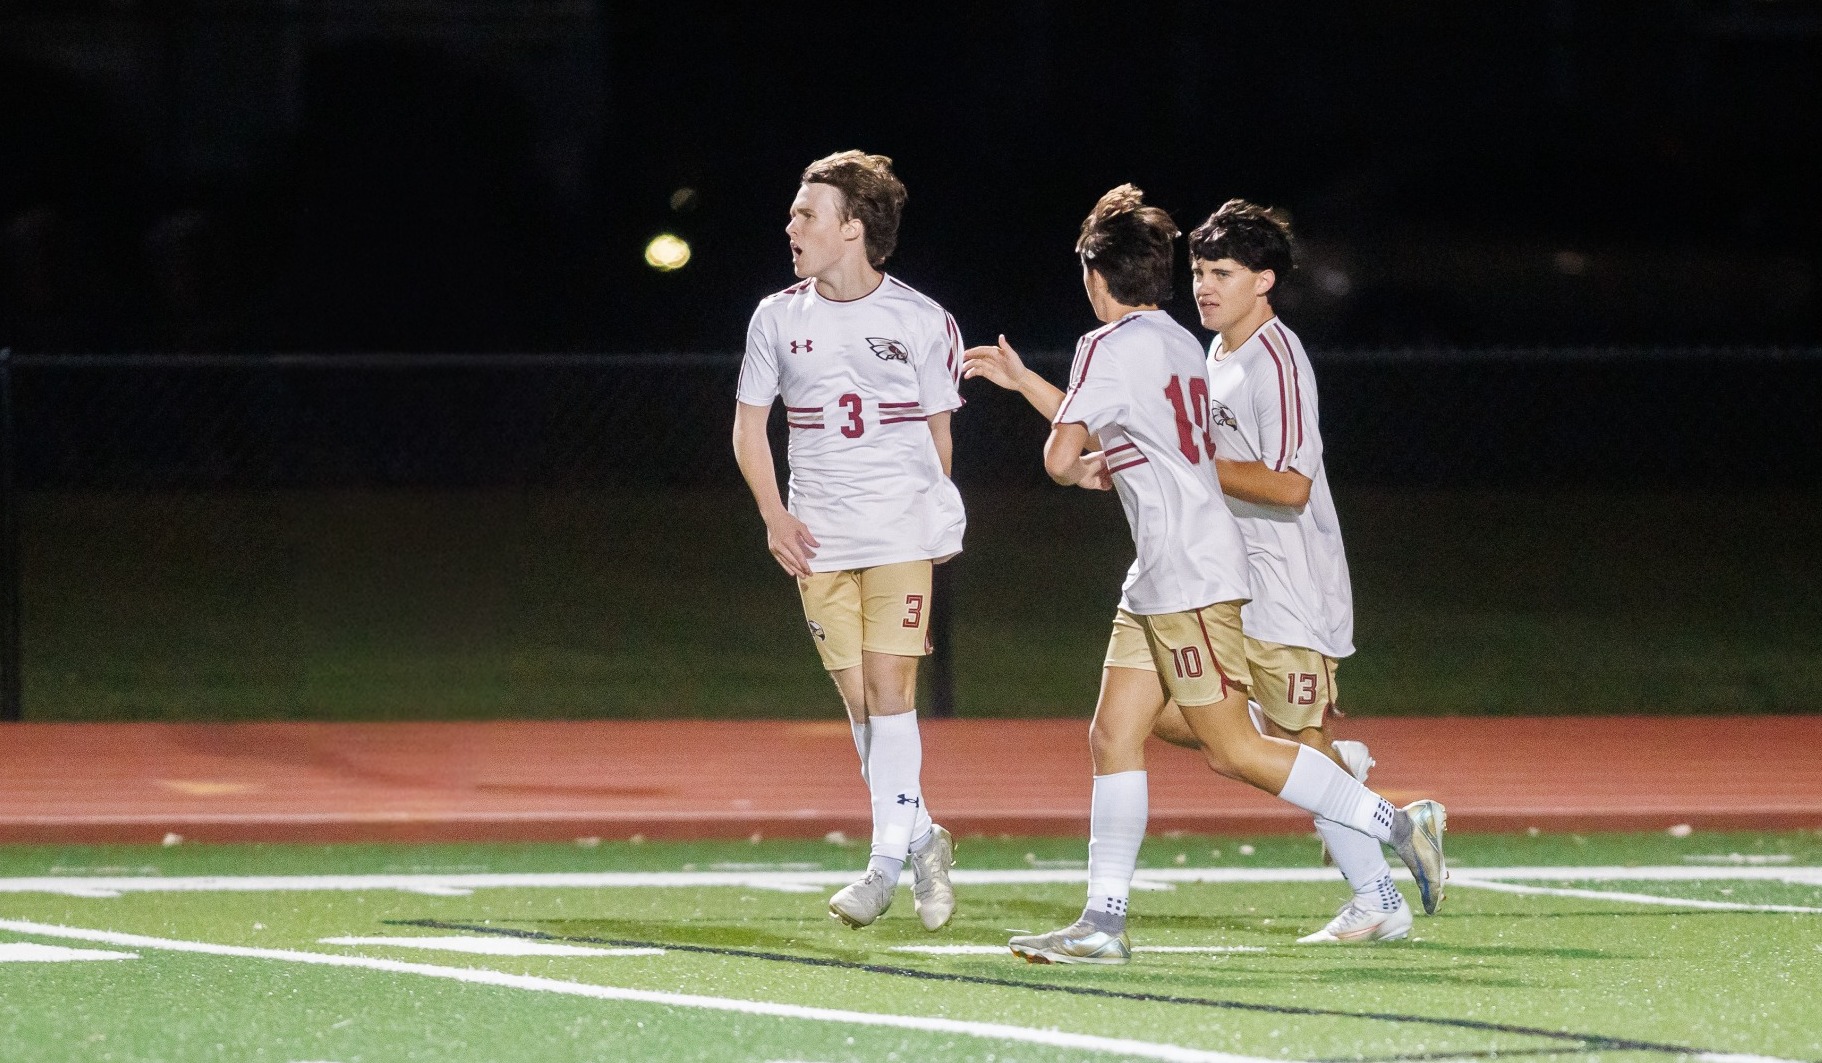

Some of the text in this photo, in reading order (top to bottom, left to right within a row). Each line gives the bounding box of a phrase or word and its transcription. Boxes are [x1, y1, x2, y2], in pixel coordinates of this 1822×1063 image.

[838, 393, 864, 438] 3
[1164, 374, 1216, 464] 10
[902, 594, 923, 628] 3
[1170, 646, 1202, 678] 10
[1287, 673, 1317, 704] 13
